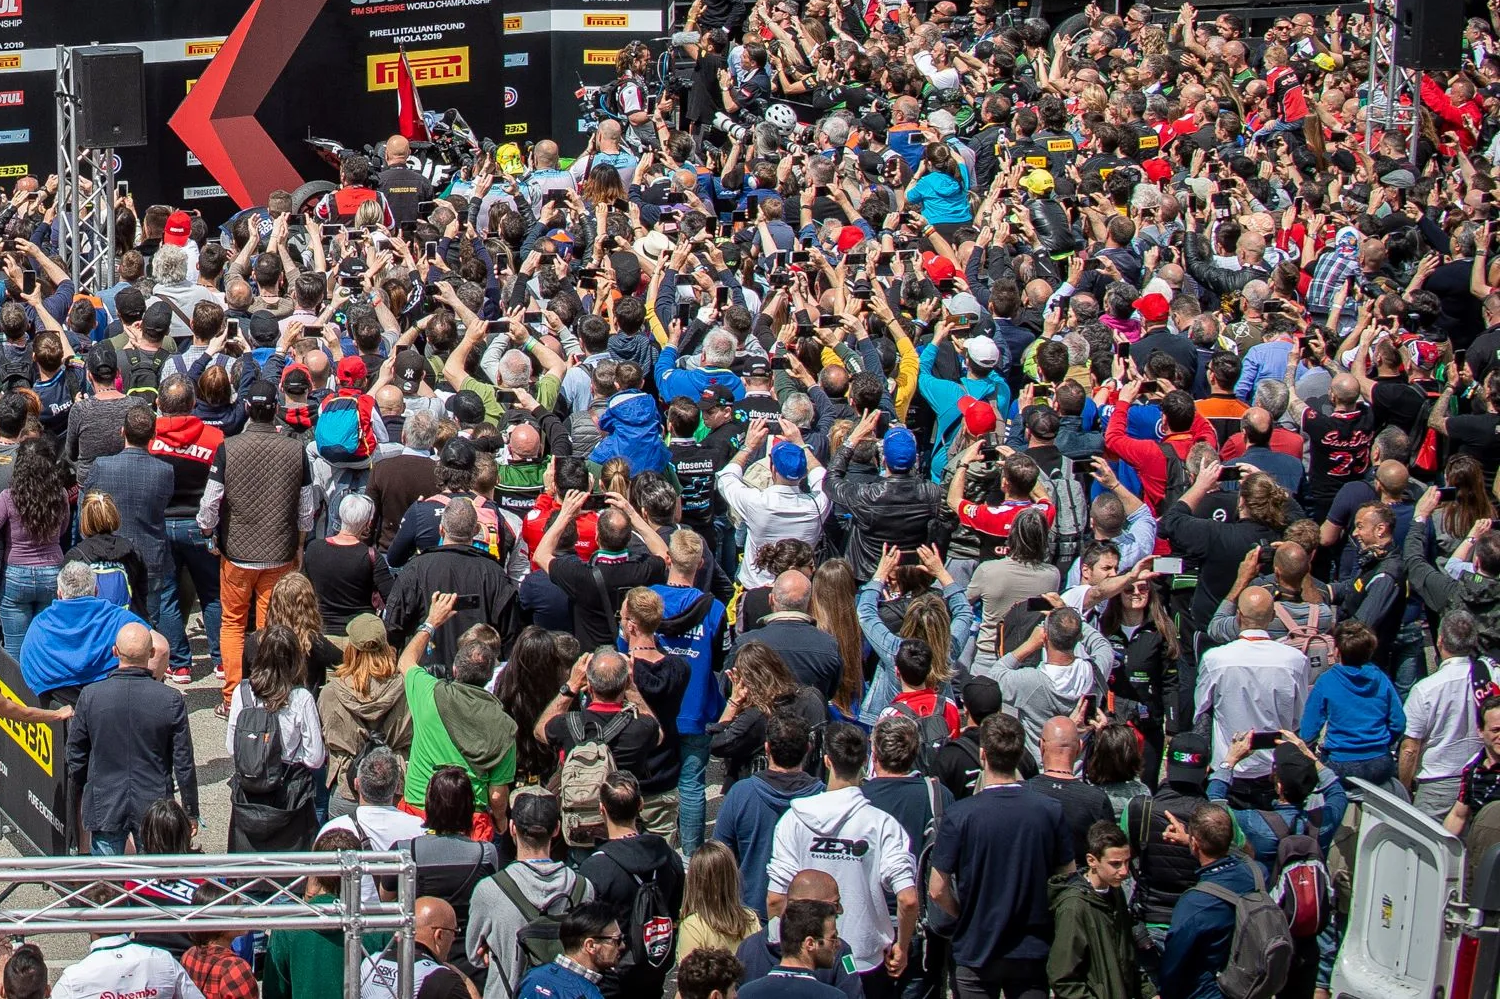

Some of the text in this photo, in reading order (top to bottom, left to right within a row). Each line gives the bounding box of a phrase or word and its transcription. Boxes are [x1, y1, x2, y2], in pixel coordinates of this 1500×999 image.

[351, 7, 365, 16] FIM
[365, 4, 405, 14] SUPERBIKE
[406, 1, 435, 11] WORLD
[587, 16, 626, 26] PIRELLI
[369, 22, 465, 38] PIRELLI ITALIAN ROUND
[393, 32, 442, 44] IMOLA 2019
[3, 41, 25, 50] 2019
[375, 55, 463, 85] PIELLI
[193, 187, 219, 197] PROSECCO
[151, 443, 213, 461] DUCATI
[677, 462, 714, 473] dtoservizi
[811, 852, 864, 865] emissions
